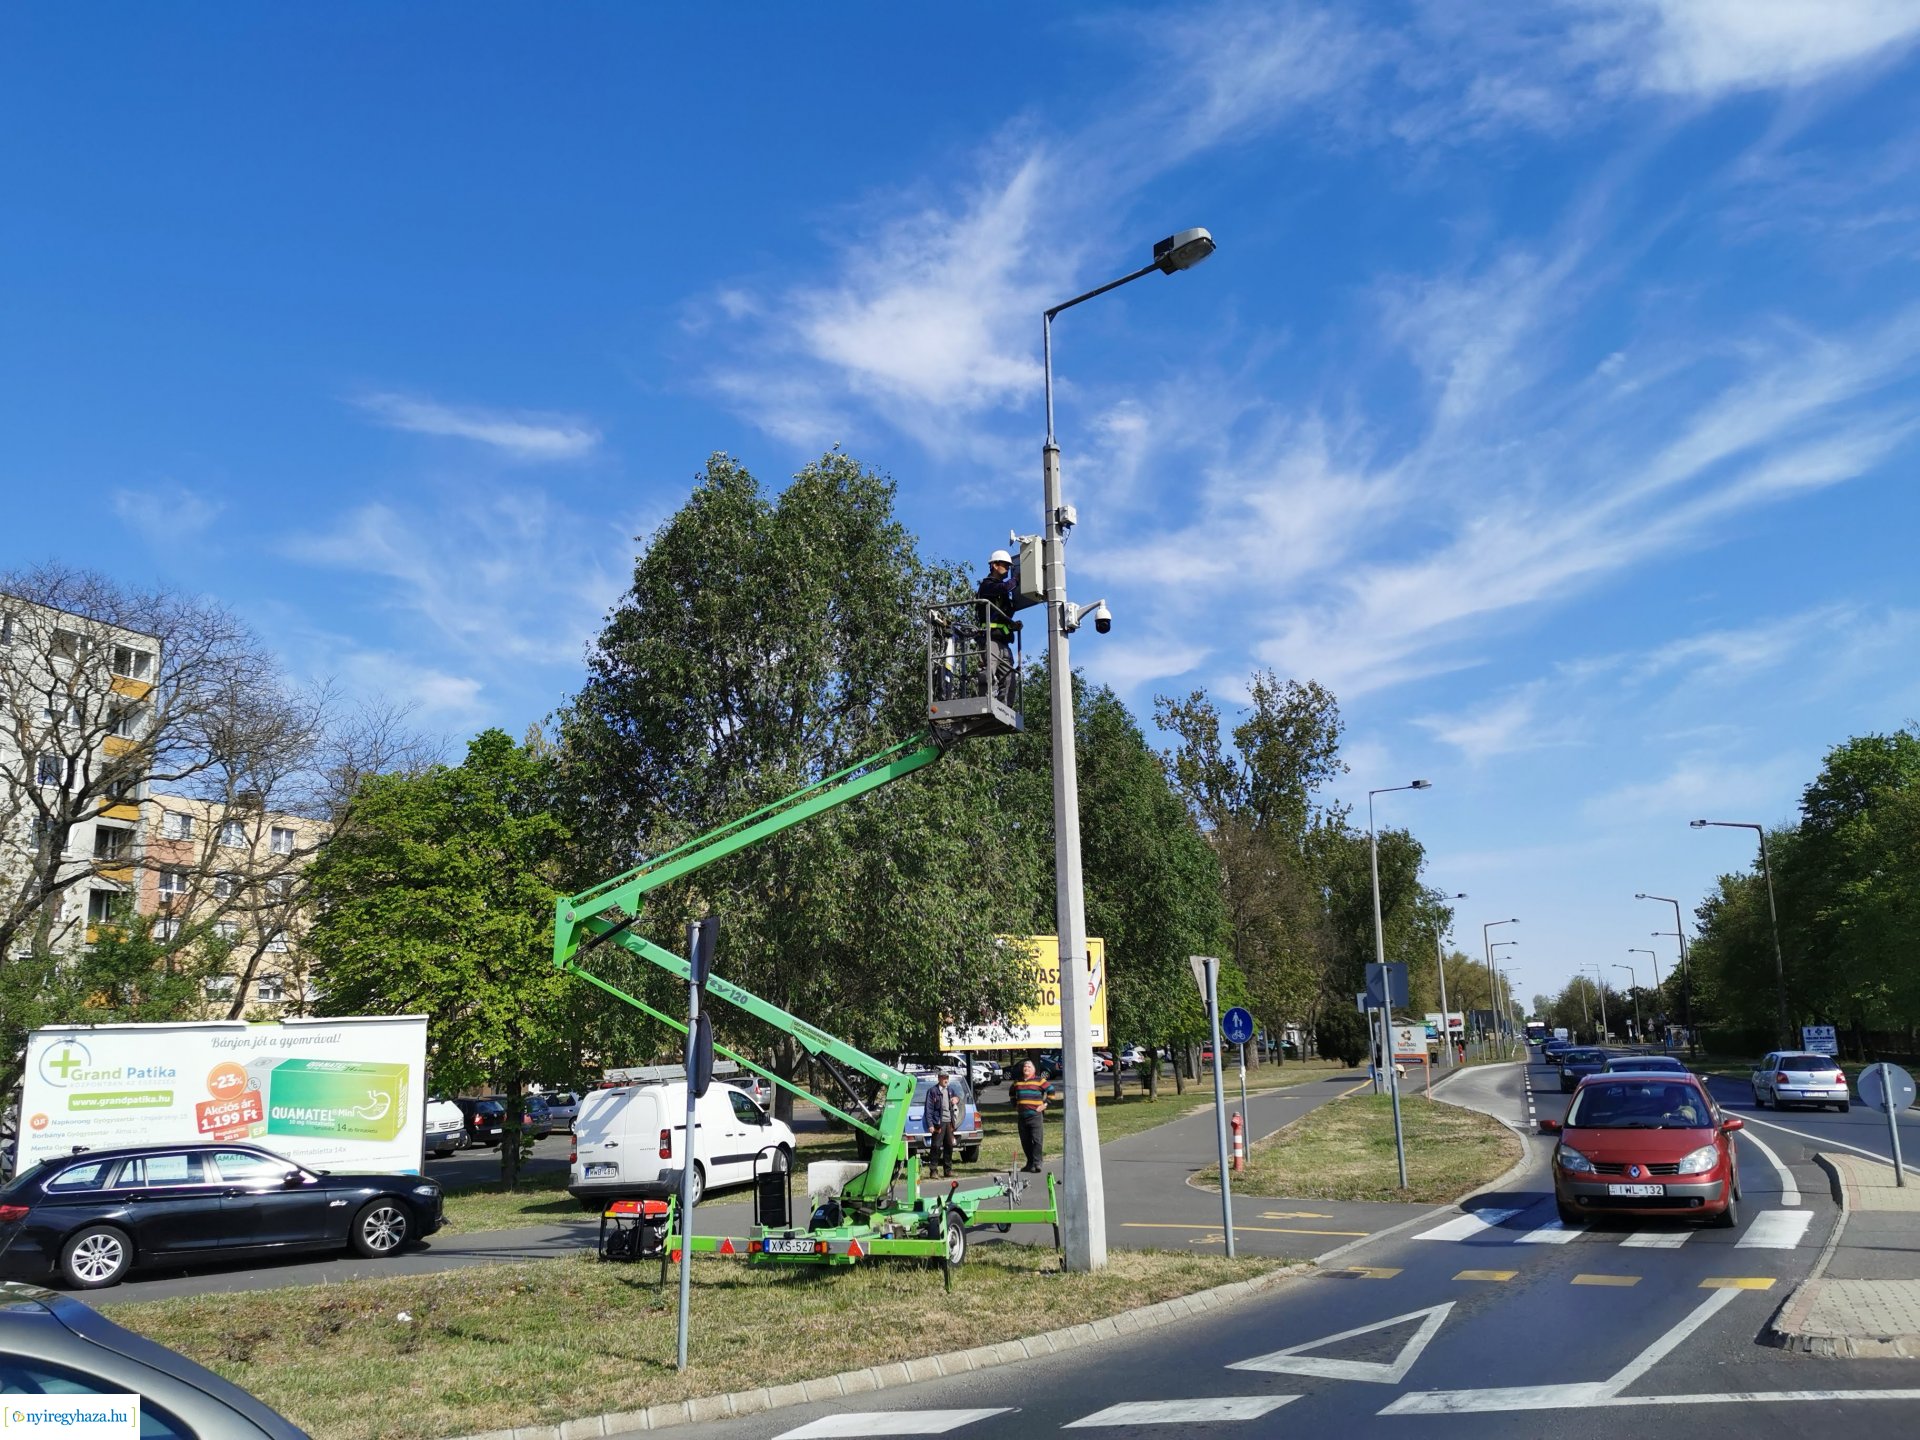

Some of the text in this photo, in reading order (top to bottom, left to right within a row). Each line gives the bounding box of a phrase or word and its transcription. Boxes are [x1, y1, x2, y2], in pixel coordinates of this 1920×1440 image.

[729, 989, 749, 1005] 120
[211, 1037, 250, 1050] Bánjon
[252, 1035, 267, 1049] jól
[280, 1033, 341, 1048] gyomrával!
[70, 1066, 176, 1081] Grand Patika
[211, 1073, 243, 1089] -23%
[72, 1095, 171, 1107] www.grandpatika.hu
[204, 1102, 240, 1116] Akciós
[201, 1109, 258, 1130] 1.199 Ft
[253, 1127, 264, 1136] EP
[337, 1123, 347, 1131] 14
[1619, 1184, 1662, 1195] IWL-132
[771, 1240, 814, 1251] XXS-527
